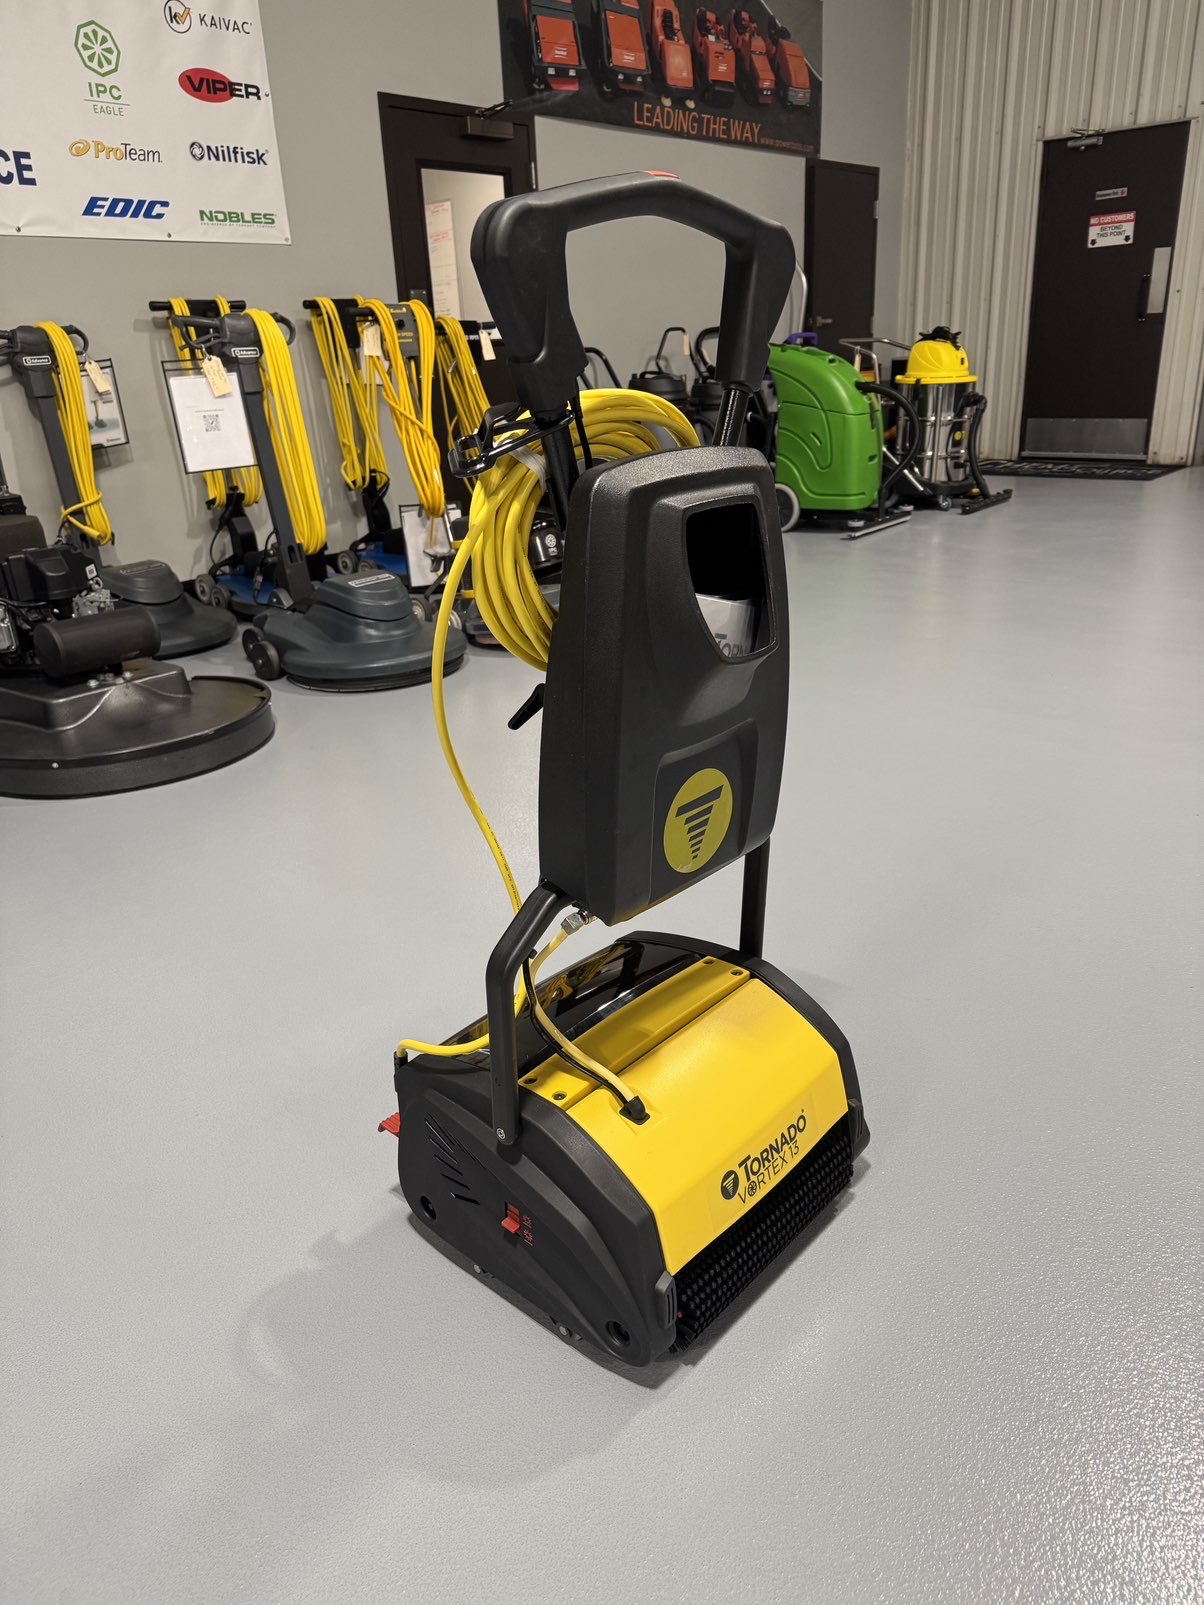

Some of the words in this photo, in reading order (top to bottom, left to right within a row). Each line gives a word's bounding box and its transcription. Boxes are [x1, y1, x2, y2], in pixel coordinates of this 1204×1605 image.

[199, 13, 251, 34] KAIVAC
[88, 82, 122, 101] IPC
[185, 75, 262, 101] VIPER
[93, 104, 125, 117] EAGLE
[634, 101, 699, 135] LEADING
[701, 113, 728, 139] THE
[730, 118, 761, 143] WAY
[94, 140, 161, 163] ProTeam
[206, 145, 268, 166] Nilfisk
[82, 196, 170, 220] EDIC
[199, 209, 276, 225] NOBLES
[1090, 217, 1100, 225] NO
[1100, 213, 1134, 224] CUSTOMERS
[738, 1114, 807, 1183] TORNADO
[738, 1150, 788, 1204] VORTEX
[788, 1139, 800, 1159] 13
